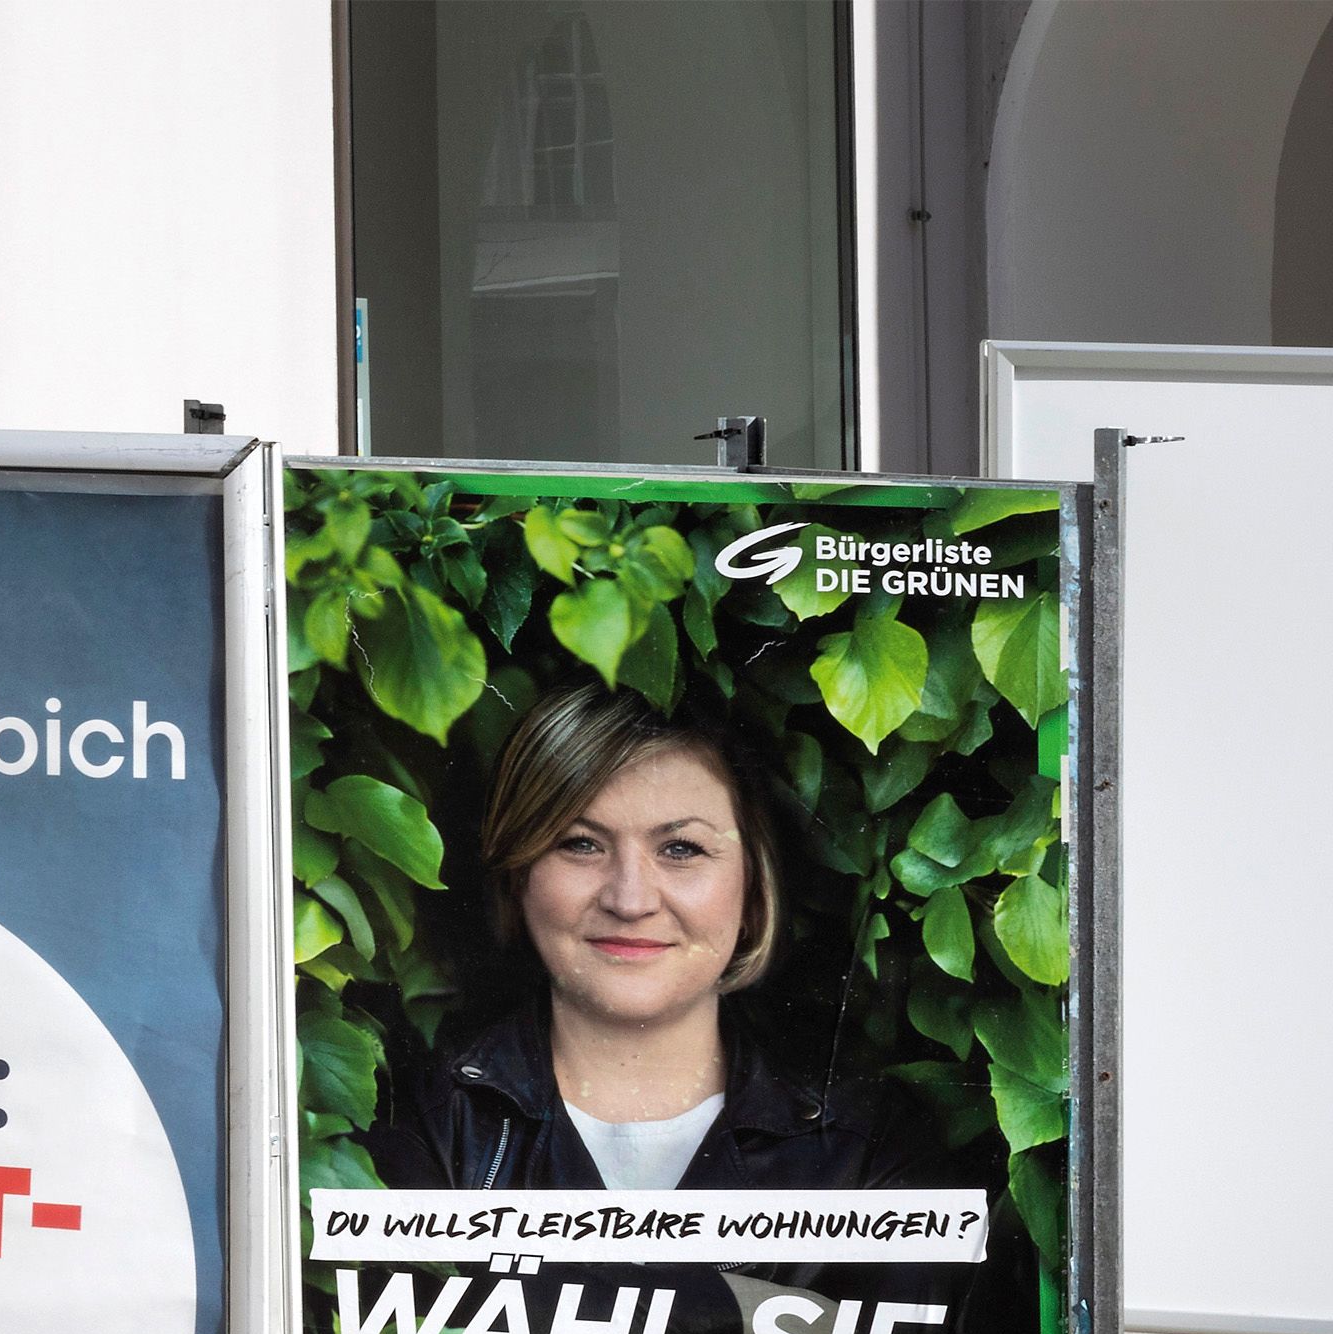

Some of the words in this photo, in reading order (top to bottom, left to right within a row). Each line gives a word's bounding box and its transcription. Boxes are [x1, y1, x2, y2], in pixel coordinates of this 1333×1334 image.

[817, 536, 991, 566] Bürgerliste
[817, 569, 870, 593] DIE
[882, 567, 1024, 598] GRÜNEN
[327, 1211, 369, 1236] DU
[384, 1207, 516, 1240] WILLST
[518, 1207, 704, 1240] LEISTBARE
